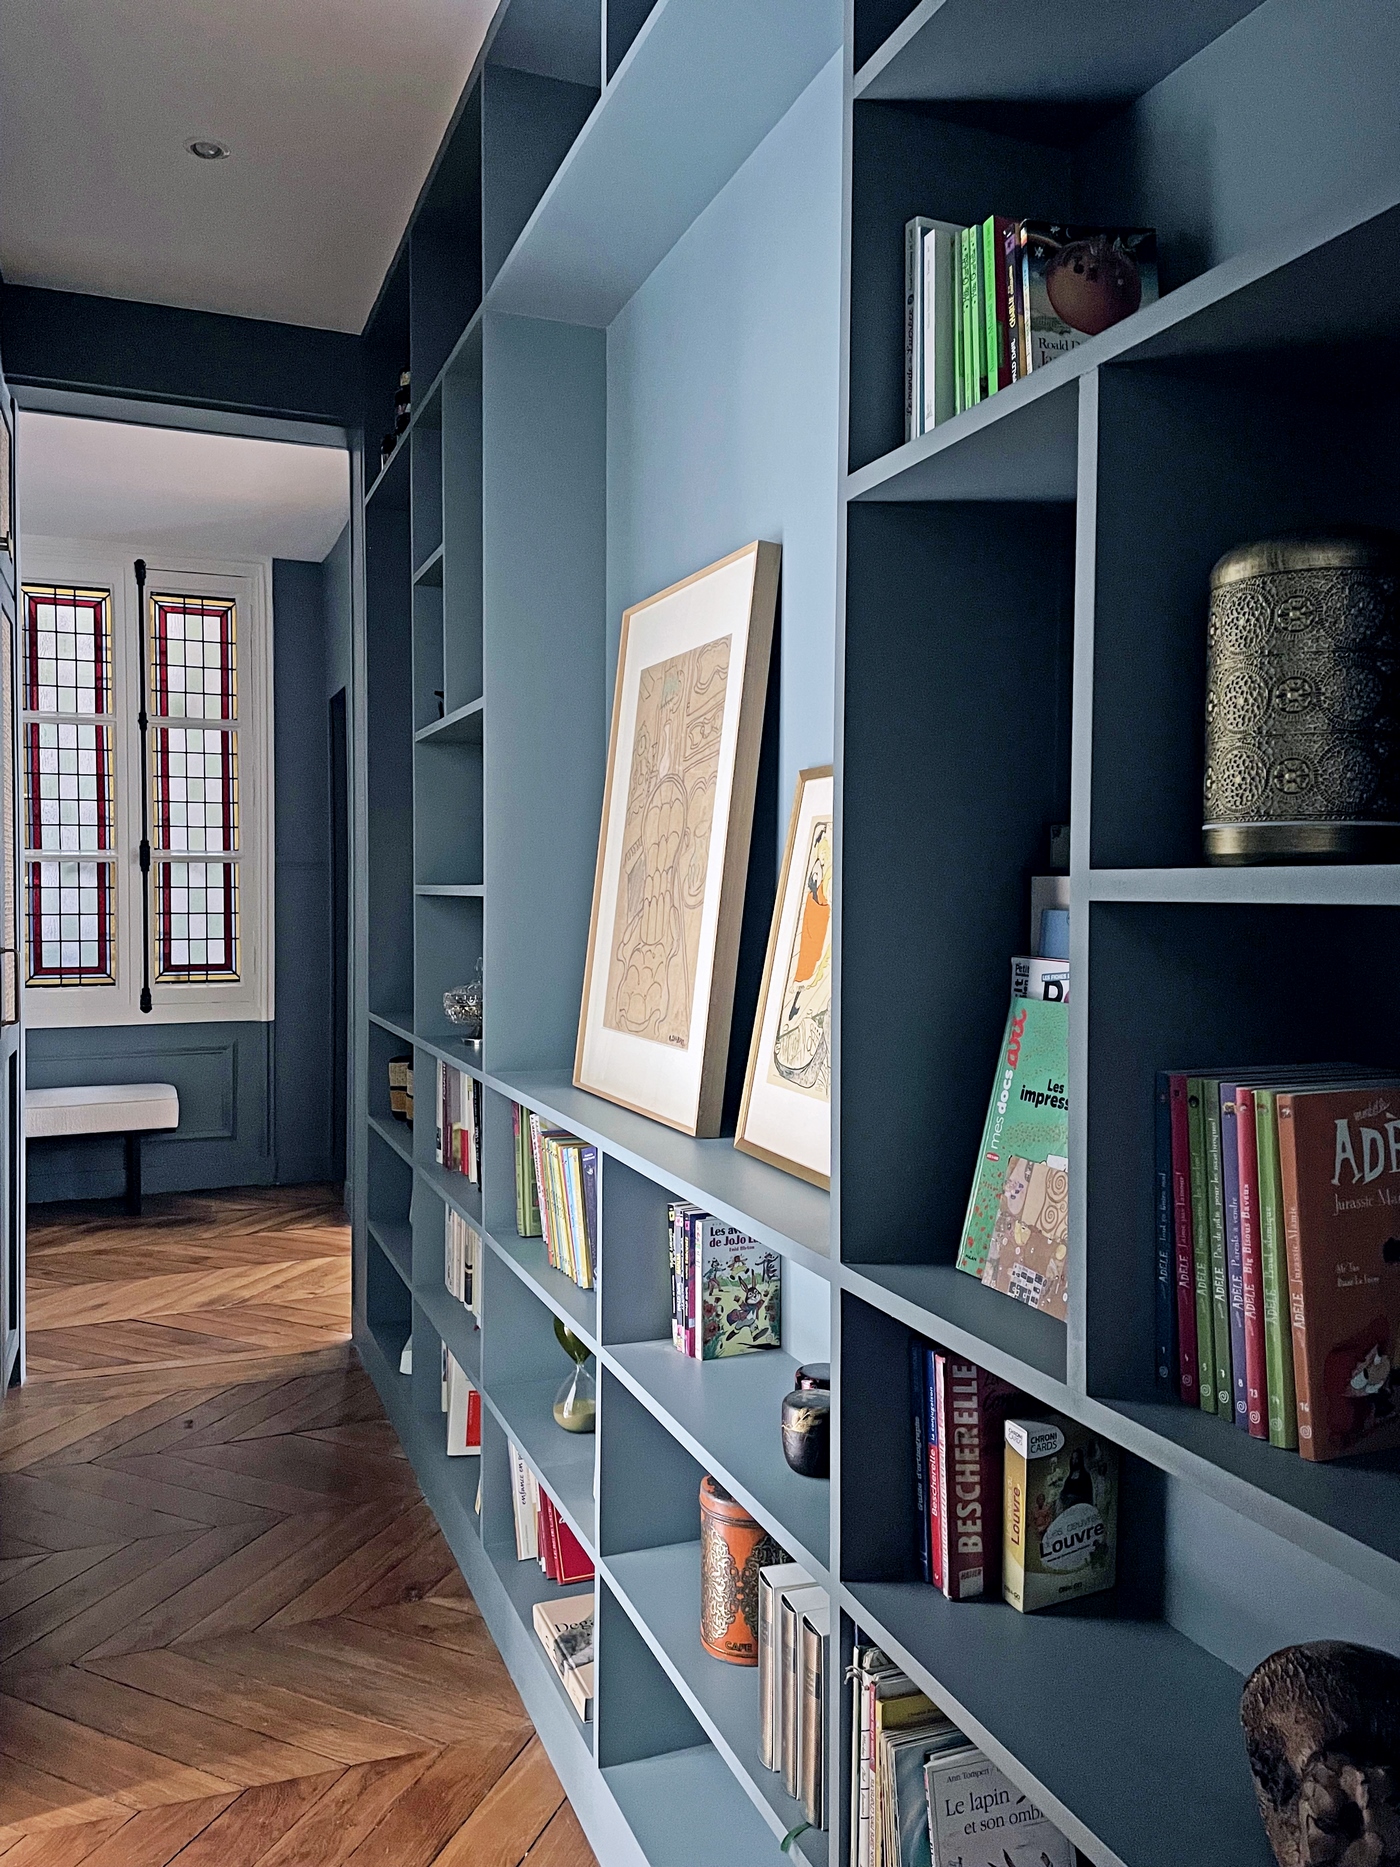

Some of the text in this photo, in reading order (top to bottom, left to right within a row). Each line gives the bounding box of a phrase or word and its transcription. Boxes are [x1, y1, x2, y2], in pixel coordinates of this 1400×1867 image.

[1008, 295, 1016, 328] CHARLIE
[1038, 337, 1069, 351] Roald
[997, 1069, 1014, 1115] docs
[1047, 1079, 1065, 1094] Les
[991, 1116, 1005, 1150] mes
[1229, 1197, 1239, 1224] vendre
[1241, 1184, 1251, 1218] Baveux
[1332, 1193, 1374, 1216] Jurassic
[709, 1238, 722, 1248] de
[723, 1235, 747, 1246] JoJo
[710, 1226, 726, 1237] Les
[1242, 1222, 1253, 1255] Bisous
[1230, 1235, 1241, 1267] Parents
[1243, 1257, 1254, 1274] Big
[1290, 1245, 1304, 1287] Jurassic
[1249, 1388, 1259, 1399] 13
[1030, 1432, 1058, 1445] CHRONI
[1030, 1440, 1058, 1454] CARDS
[952, 1364, 984, 1554] BESCHERELLE
[518, 1475, 527, 1505] enfance
[929, 1448, 938, 1517] Bescherelle
[1011, 1486, 1021, 1547] Louvre
[1040, 1522, 1106, 1559] Louvre
[555, 1620, 595, 1633] Deg
[946, 1773, 962, 1784] Ann
[962, 1767, 990, 1781] Tompert
[945, 1788, 1011, 1817] Le lapin
[964, 1821, 977, 1835] et
[980, 1815, 1005, 1832] son
